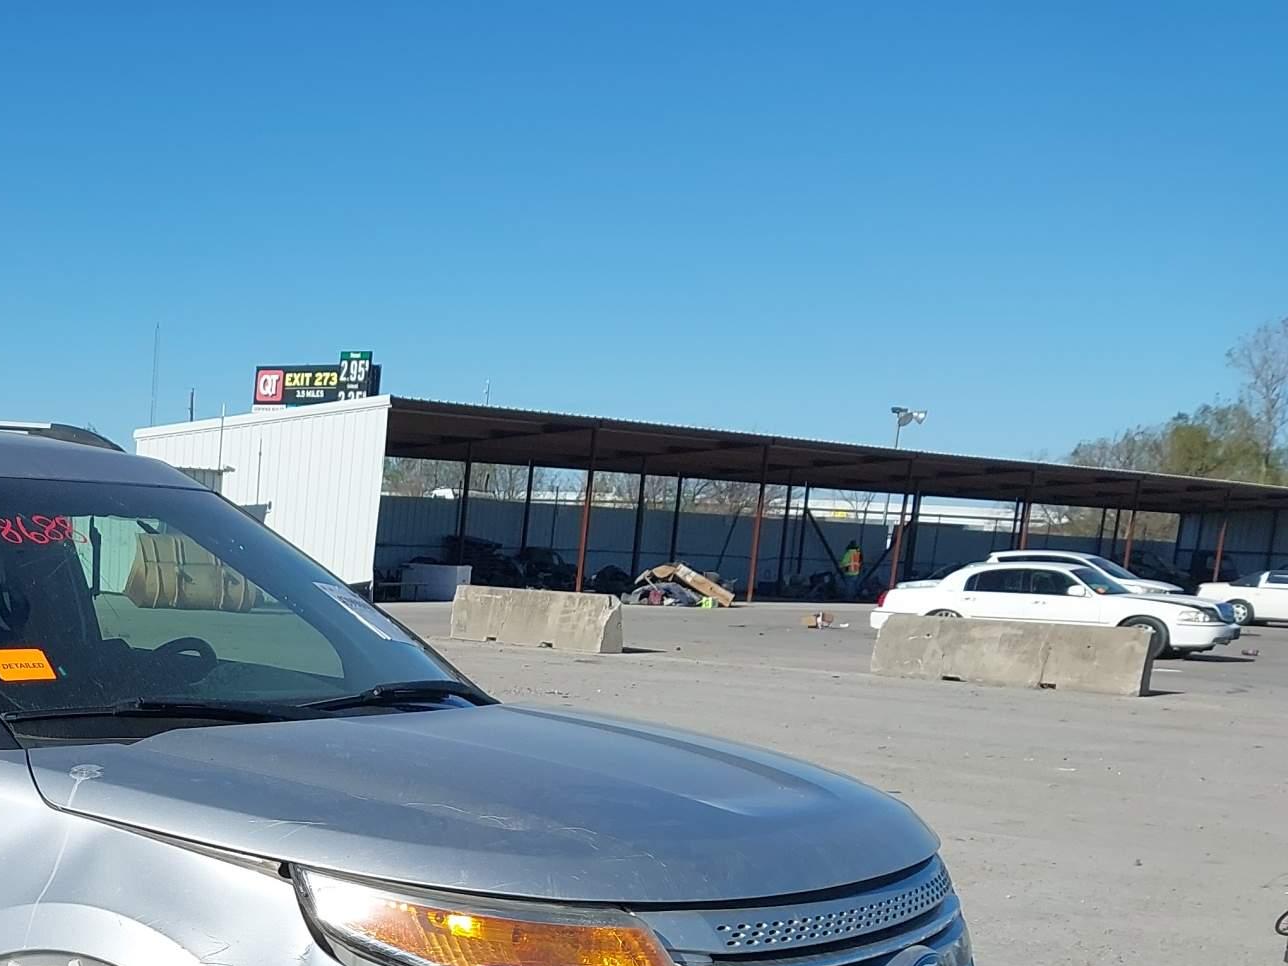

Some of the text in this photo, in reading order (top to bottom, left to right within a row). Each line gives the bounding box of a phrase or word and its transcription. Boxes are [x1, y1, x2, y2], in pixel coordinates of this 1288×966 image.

[285, 372, 338, 386] EXIT 273
[259, 374, 280, 396] QT
[306, 389, 324, 398] MILES
[1, 662, 45, 670] DETAILED
